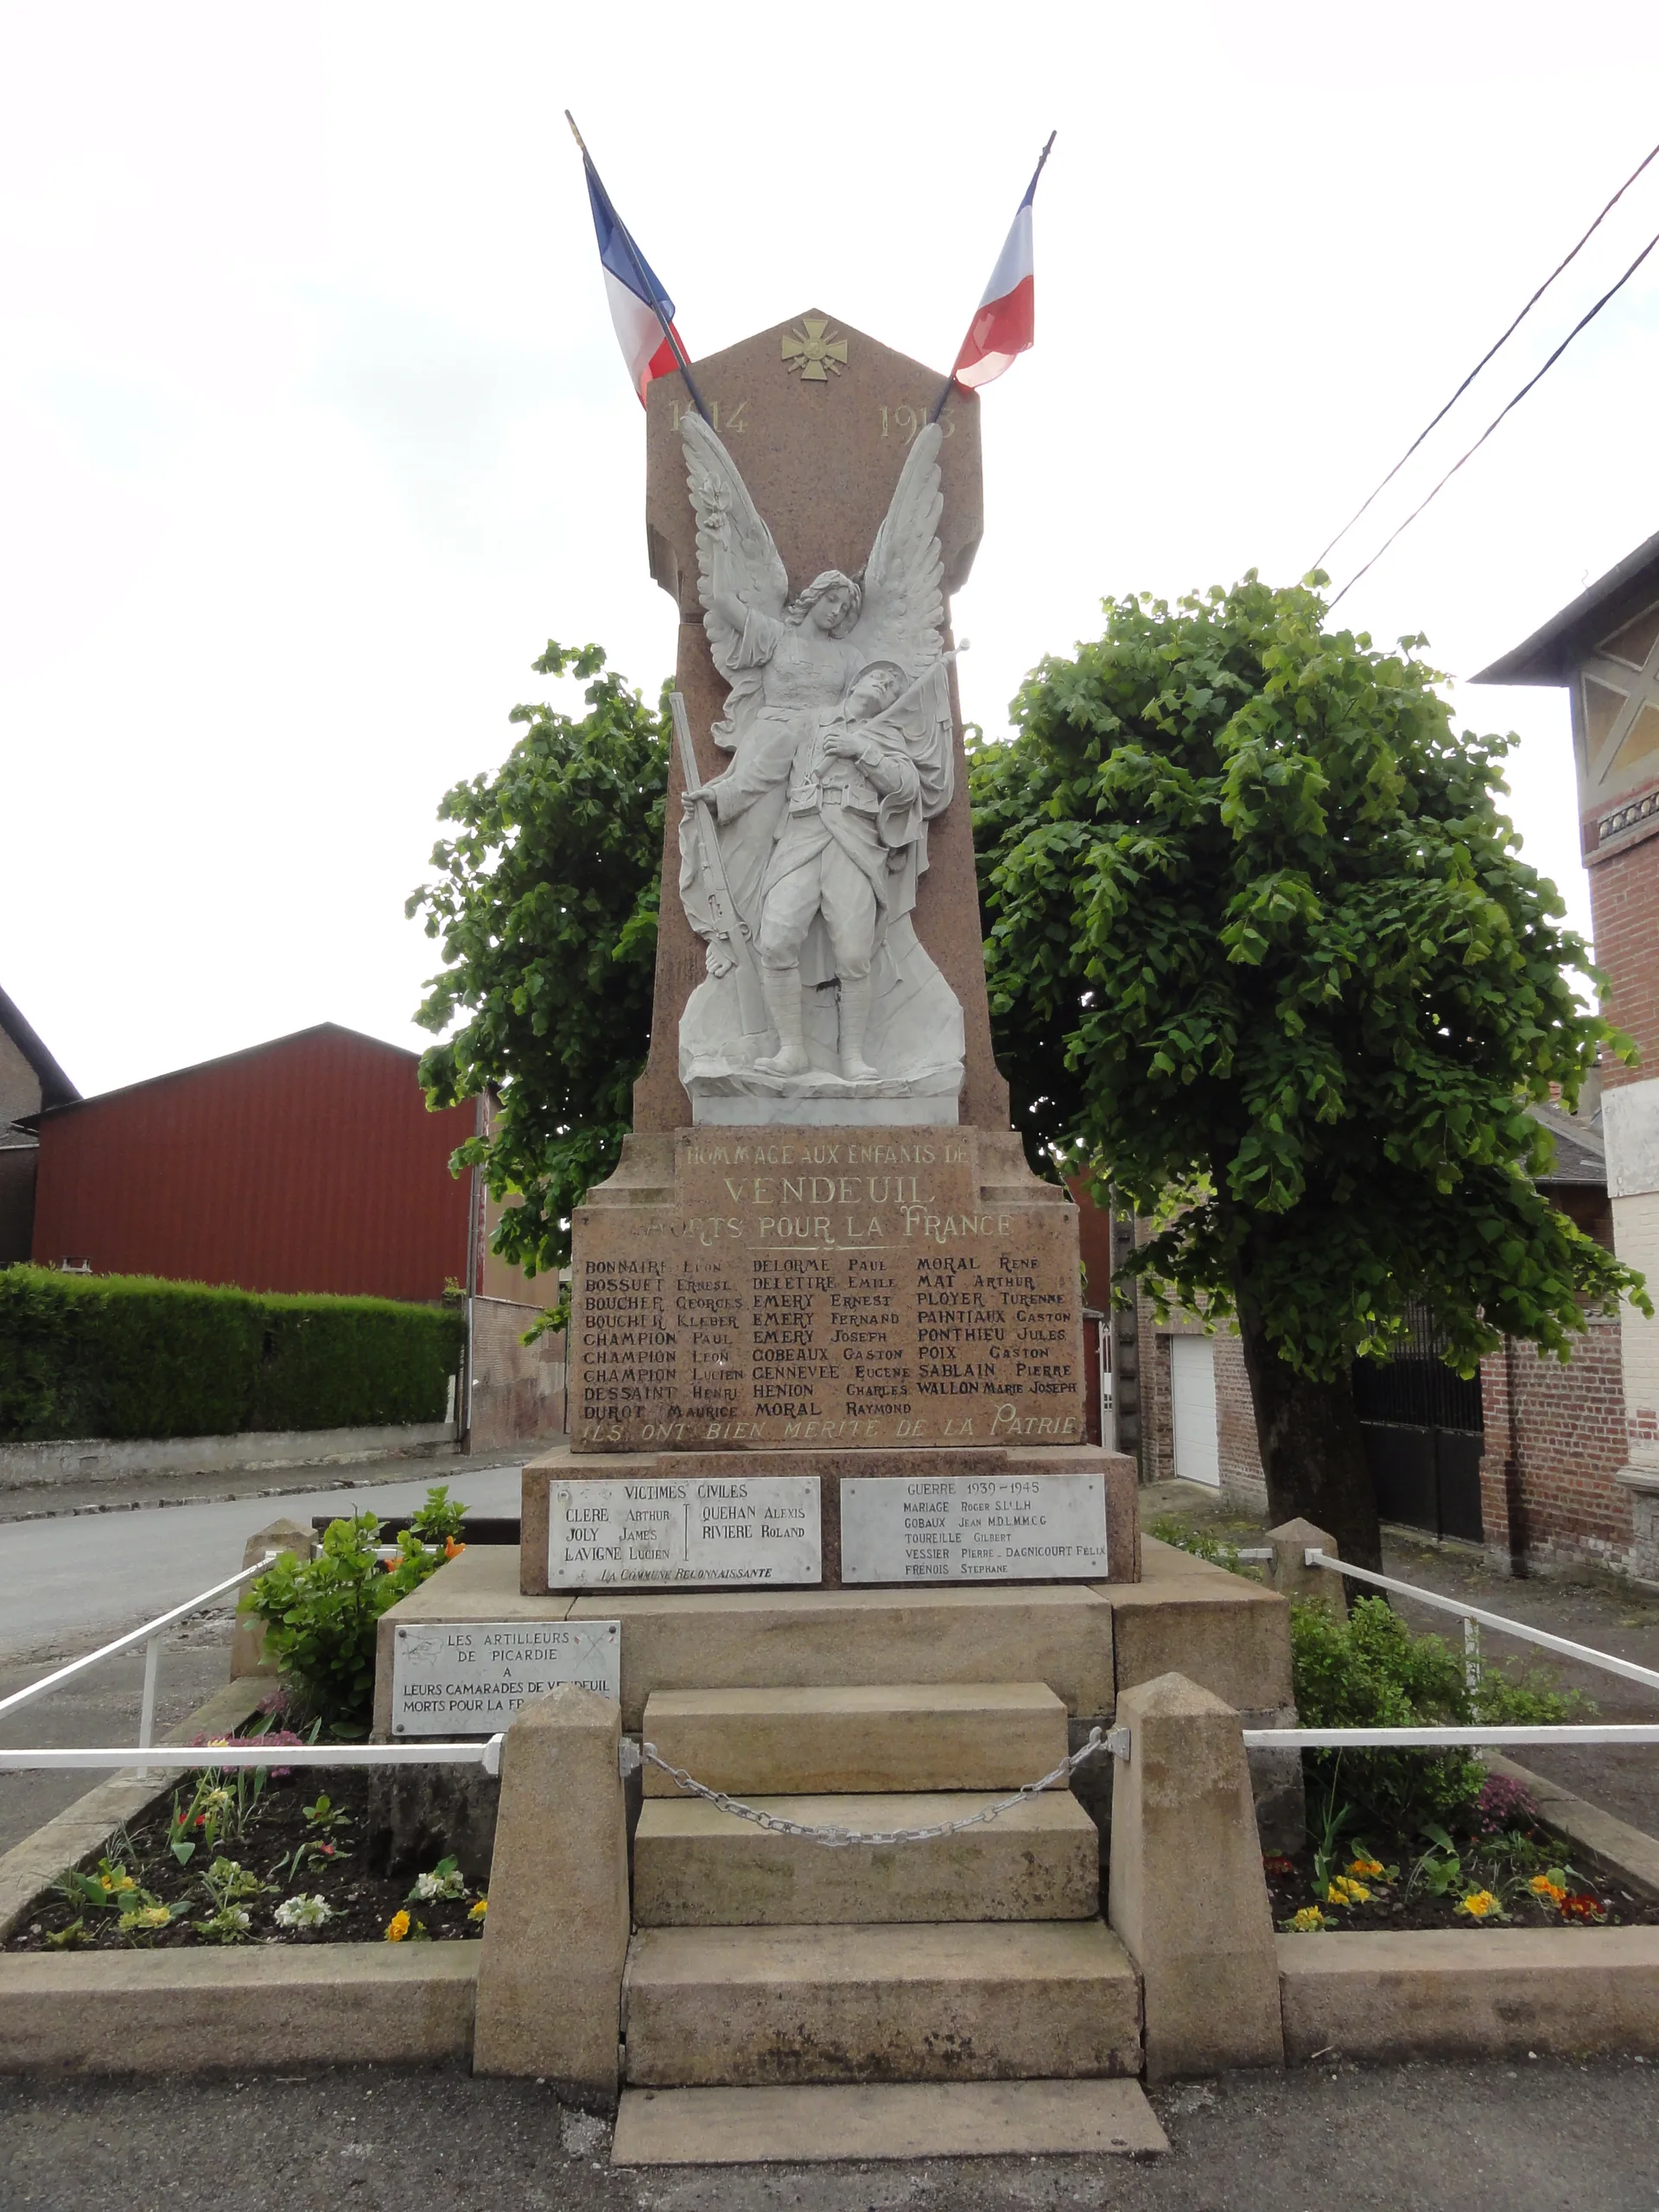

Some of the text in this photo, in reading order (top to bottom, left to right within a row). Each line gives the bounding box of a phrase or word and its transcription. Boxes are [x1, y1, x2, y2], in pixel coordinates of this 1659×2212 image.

[669, 398, 750, 432] 114
[687, 1144, 969, 1164] HOMMAGE AUX ENFANTS DE
[723, 1176, 936, 1204] VENDEUIL
[760, 1216, 836, 1243] POUR
[846, 1216, 883, 1236] LA
[900, 1205, 1014, 1243] FRANCE
[753, 1259, 887, 1273] DELORME PAUL
[917, 1257, 980, 1274] MORAL
[585, 1279, 664, 1292] BOSSUET
[753, 1276, 897, 1292] DELETTRE EMILE
[917, 1274, 1036, 1291] MAT ARTHUR
[585, 1296, 743, 1313] BOUCHER GEORGES
[753, 1294, 891, 1311] EMERY ERNEST
[917, 1292, 1065, 1307] PLOYER TURENNE
[585, 1314, 740, 1330] BOUCHER KLEBER
[753, 1312, 899, 1328] EMERY FERNAND
[918, 1310, 1071, 1324] PAINTIAUX GASTON
[583, 1332, 733, 1346] CHAMPION PAUL
[753, 1329, 887, 1346] EMERY JOSEPH
[918, 1327, 1066, 1342] PONTHIEU JULES
[583, 1351, 728, 1364] CHAMPION LEON
[753, 1348, 904, 1362] GOBEAUX GASTON
[918, 1346, 1050, 1359] POIX GASTON
[583, 1368, 743, 1382] CHAMPION LUCIEN
[753, 1365, 911, 1380] GENNEVEE EUGENE
[918, 1363, 1072, 1378] SABLAIN PIERRE
[584, 1386, 737, 1401] DESSAINT HENRI
[753, 1383, 908, 1398] HENION CHARLES
[916, 1382, 1077, 1396] WALLON MARIE JOSEPH
[584, 1405, 738, 1422] DUROT MAURICE
[755, 1402, 912, 1419] MORAL RAYMOND
[583, 1425, 623, 1442] ILS
[641, 1423, 685, 1442] ONT
[706, 1421, 766, 1440] BIEN
[896, 1419, 928, 1437] DE
[944, 1418, 974, 1435] LA
[989, 1403, 1077, 1435] PATRIE
[624, 1484, 747, 1500] VICTIMES CIVILES
[908, 1484, 957, 1495] GUERRE
[702, 1505, 805, 1522] QUEHAN ALEXIS
[903, 1502, 949, 1512] MARIAGE
[961, 1502, 989, 1511] ROGER
[566, 1508, 671, 1522] CLERE ARTHUR
[905, 1517, 945, 1529] GOBAUX
[958, 1517, 982, 1528] JEAN
[565, 1527, 658, 1541] JOLY JAMES
[702, 1525, 804, 1539] RIVIERE ROLAND
[905, 1532, 1012, 1543] TOUREILLE GILBERT
[564, 1547, 670, 1561] LAVIGNE LUCIEN
[906, 1548, 950, 1559] VESSIER
[961, 1548, 994, 1558] PIERRE
[1006, 1546, 1072, 1556] DAGNICOURT
[601, 1568, 772, 1581] LA COMMUNE RECONNAISSANTE
[448, 1632, 569, 1646] LES ARTILLEURS
[458, 1649, 557, 1662] DE PICARDIE
[503, 1667, 512, 1677] A
[404, 1680, 610, 1696] LEURS CAMARADES DE VDEUIL
[404, 1700, 445, 1712] MORTS
[449, 1700, 483, 1711] POUR
[487, 1700, 504, 1711] LA
